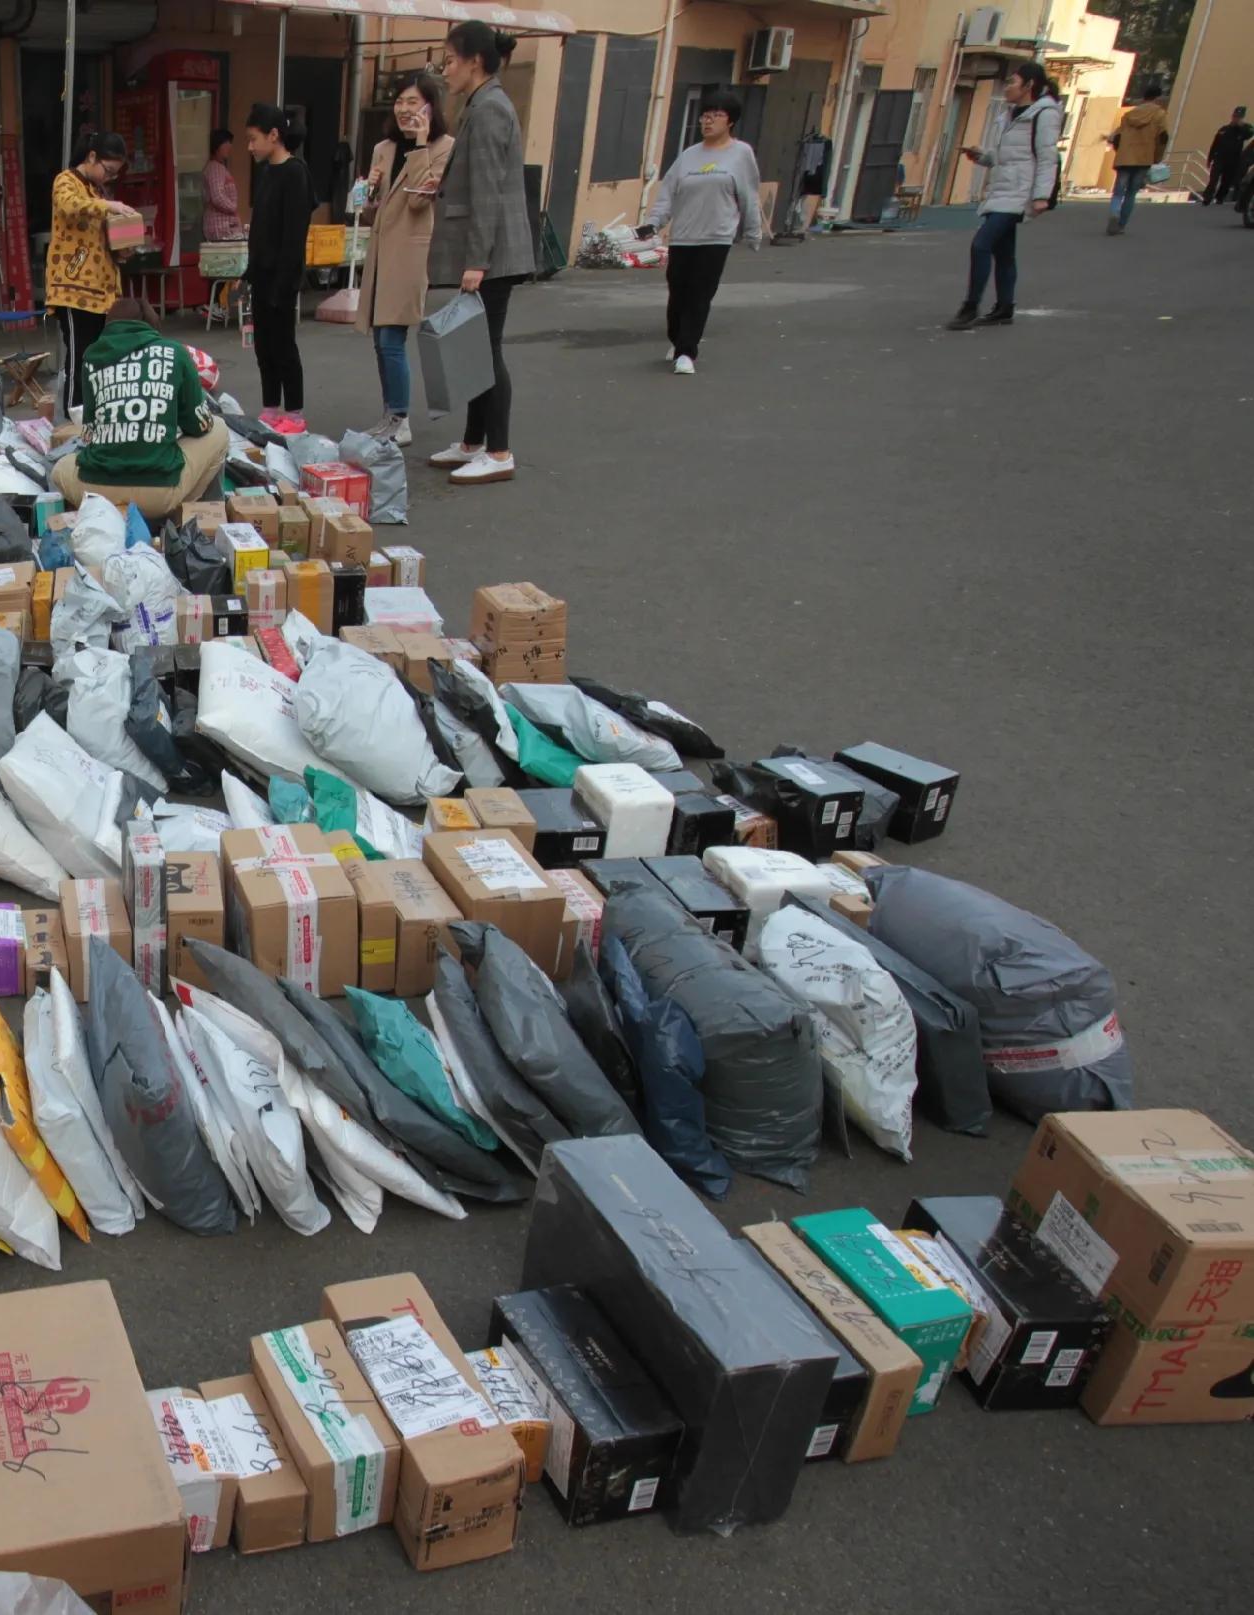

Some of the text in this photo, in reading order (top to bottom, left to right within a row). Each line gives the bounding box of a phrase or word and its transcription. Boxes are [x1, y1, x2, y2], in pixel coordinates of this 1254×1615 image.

[88, 359, 174, 396] TIRED OF
[142, 381, 174, 400] OVER
[94, 398, 168, 425] STOP
[144, 422, 166, 443] UP
[304, 1345, 386, 1427] 9262
